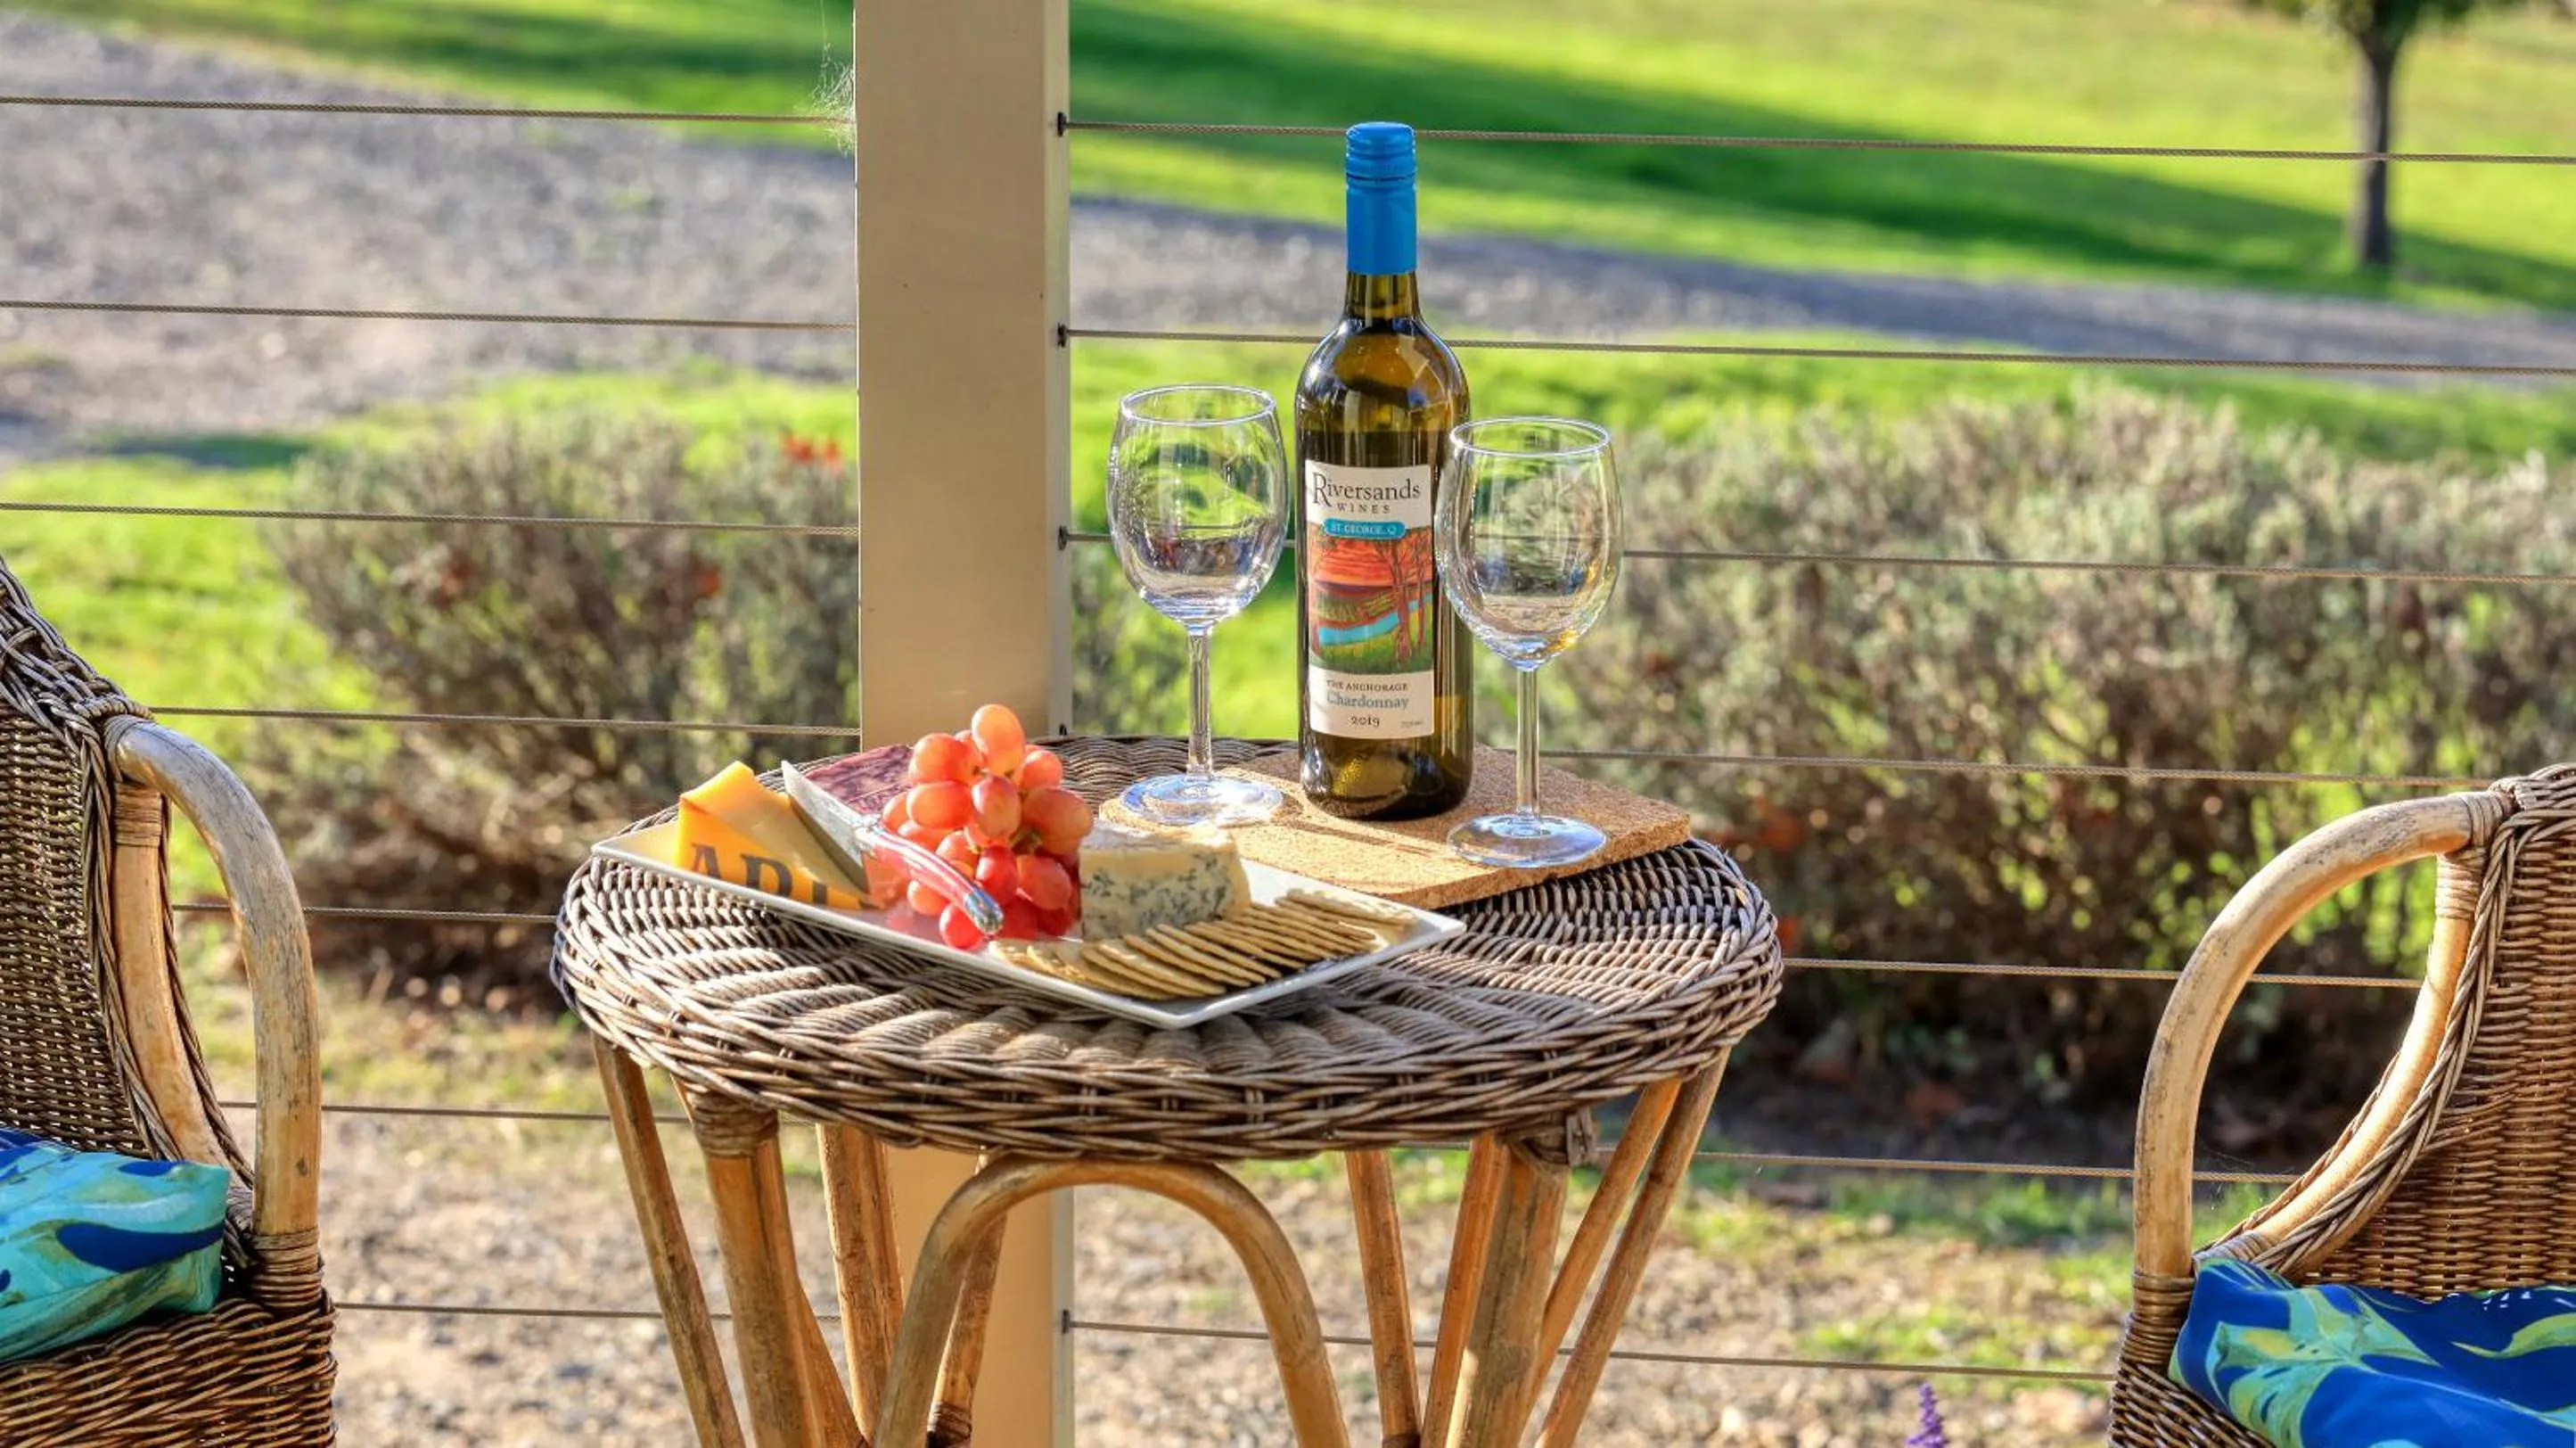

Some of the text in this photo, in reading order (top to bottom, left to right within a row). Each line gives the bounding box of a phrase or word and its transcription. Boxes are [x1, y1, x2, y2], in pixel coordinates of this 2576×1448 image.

[1312, 473, 1421, 506] Riversands
[1337, 503, 1391, 514] WINES
[1326, 679, 1408, 692] THE ANCHORAGE
[1326, 690, 1409, 711] Chardonnay
[1350, 716, 1381, 728] 2019
